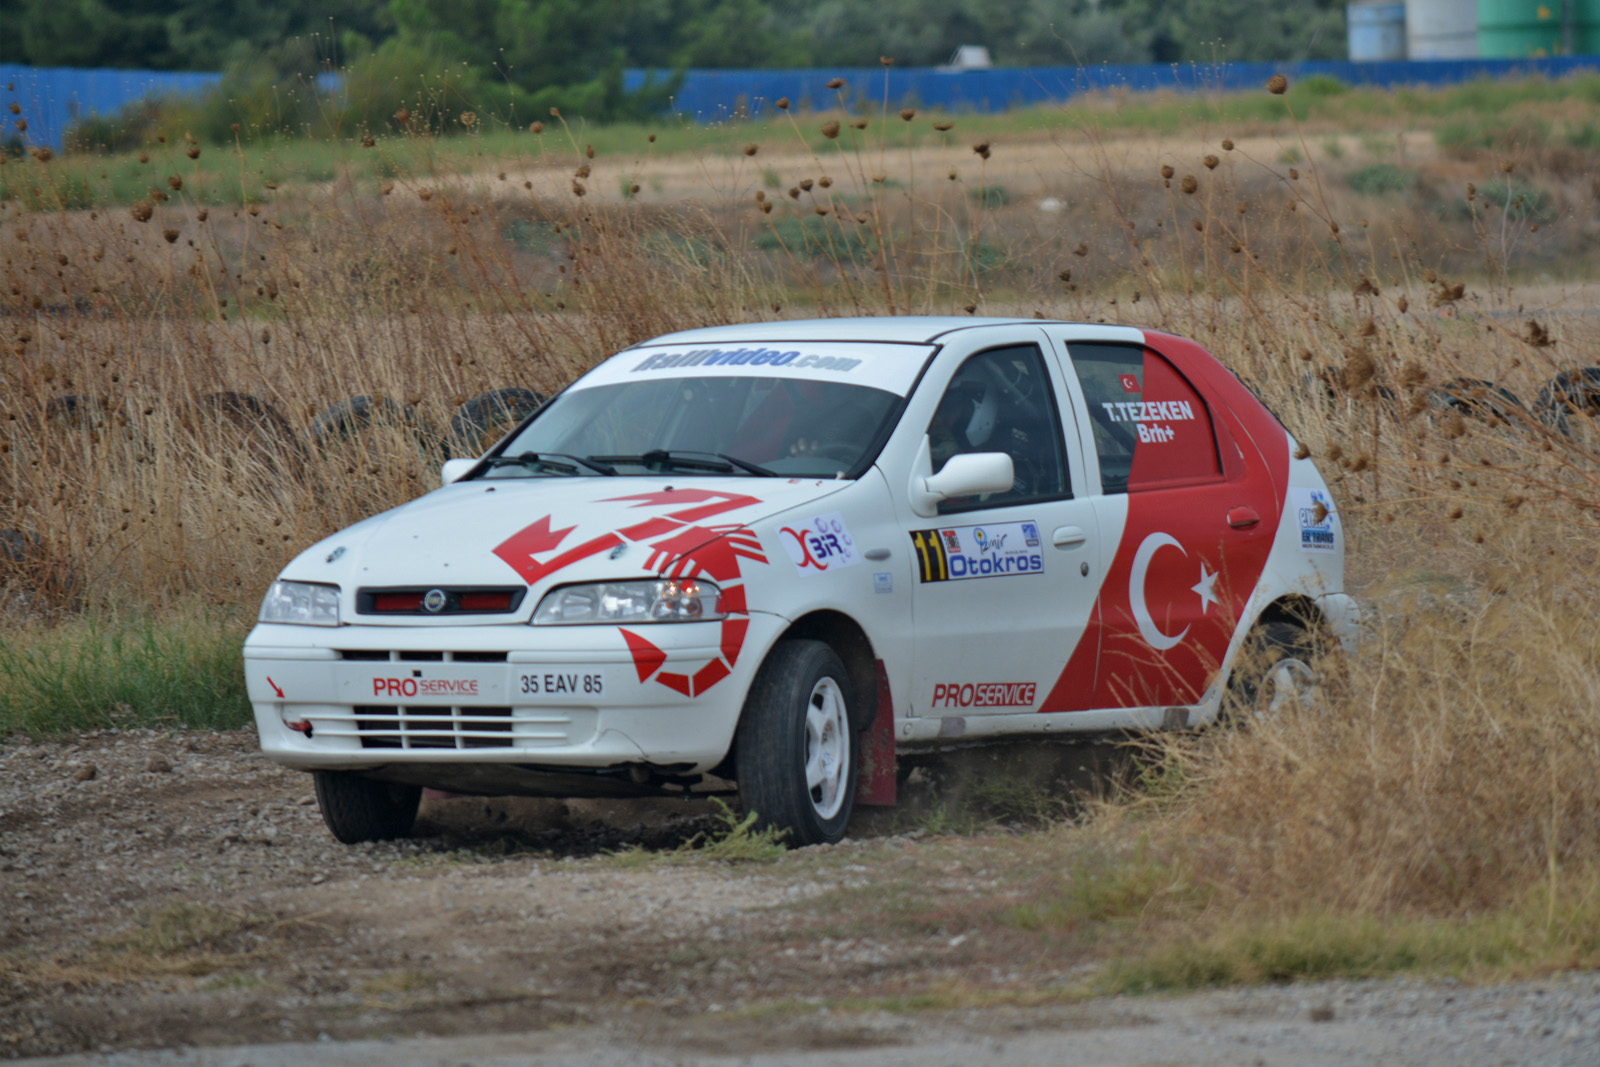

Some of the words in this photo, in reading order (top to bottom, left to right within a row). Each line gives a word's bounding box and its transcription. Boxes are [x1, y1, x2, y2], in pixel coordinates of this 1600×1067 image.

[914, 530, 946, 581] 11
[949, 552, 1042, 577] Otokros
[373, 678, 418, 697] PRO
[419, 679, 479, 692] SERVICE
[521, 675, 539, 693] 35
[544, 675, 577, 693] EAV
[583, 675, 603, 693] 85
